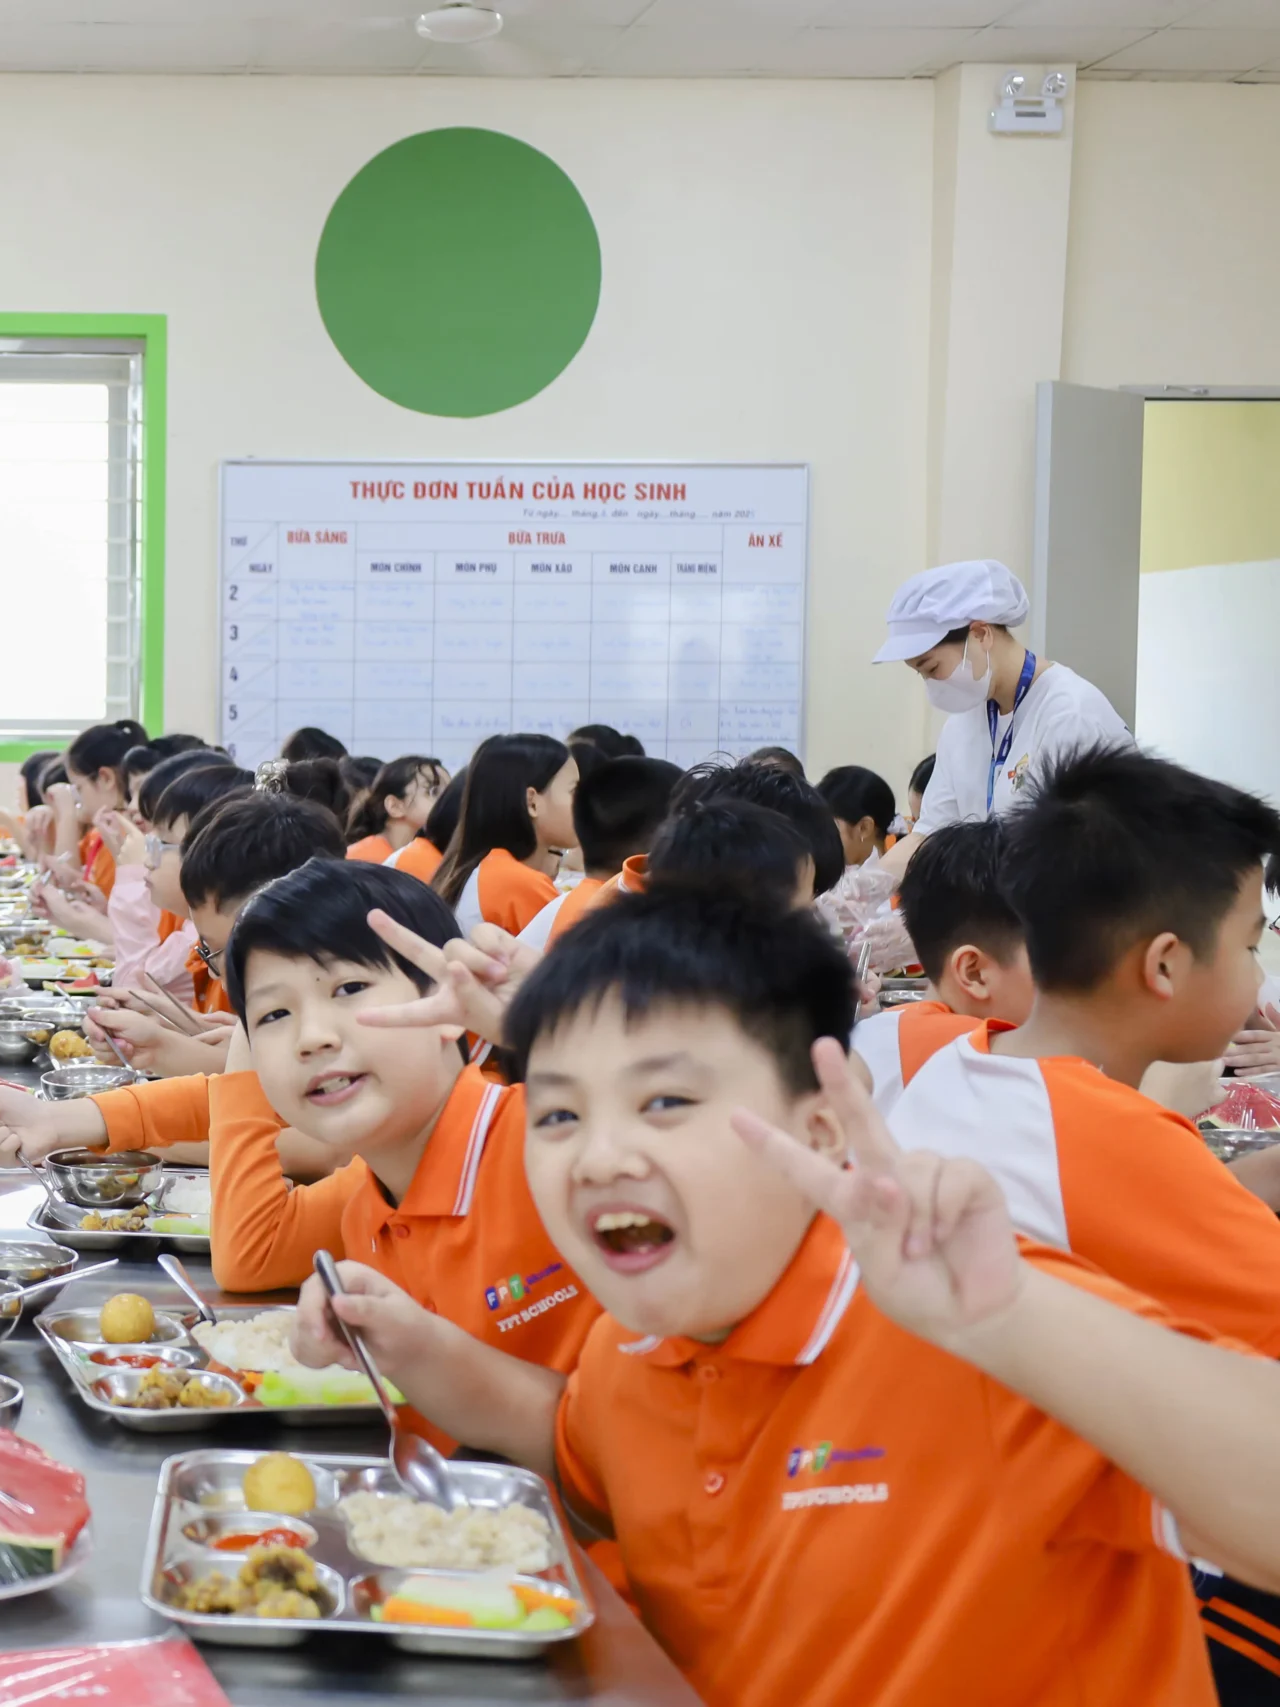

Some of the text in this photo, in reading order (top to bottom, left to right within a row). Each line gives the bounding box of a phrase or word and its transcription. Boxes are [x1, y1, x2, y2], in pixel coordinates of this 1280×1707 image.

[350, 480, 405, 503] THỰC
[413, 480, 458, 499] ĐƠN
[532, 475, 575, 500] CỦA
[583, 482, 626, 503] HỌC
[634, 482, 687, 500] SINH
[229, 585, 239, 601] 2
[229, 625, 239, 641] 3
[229, 667, 239, 681] 4
[228, 704, 238, 720] 5
[486, 1275, 524, 1310] FPT
